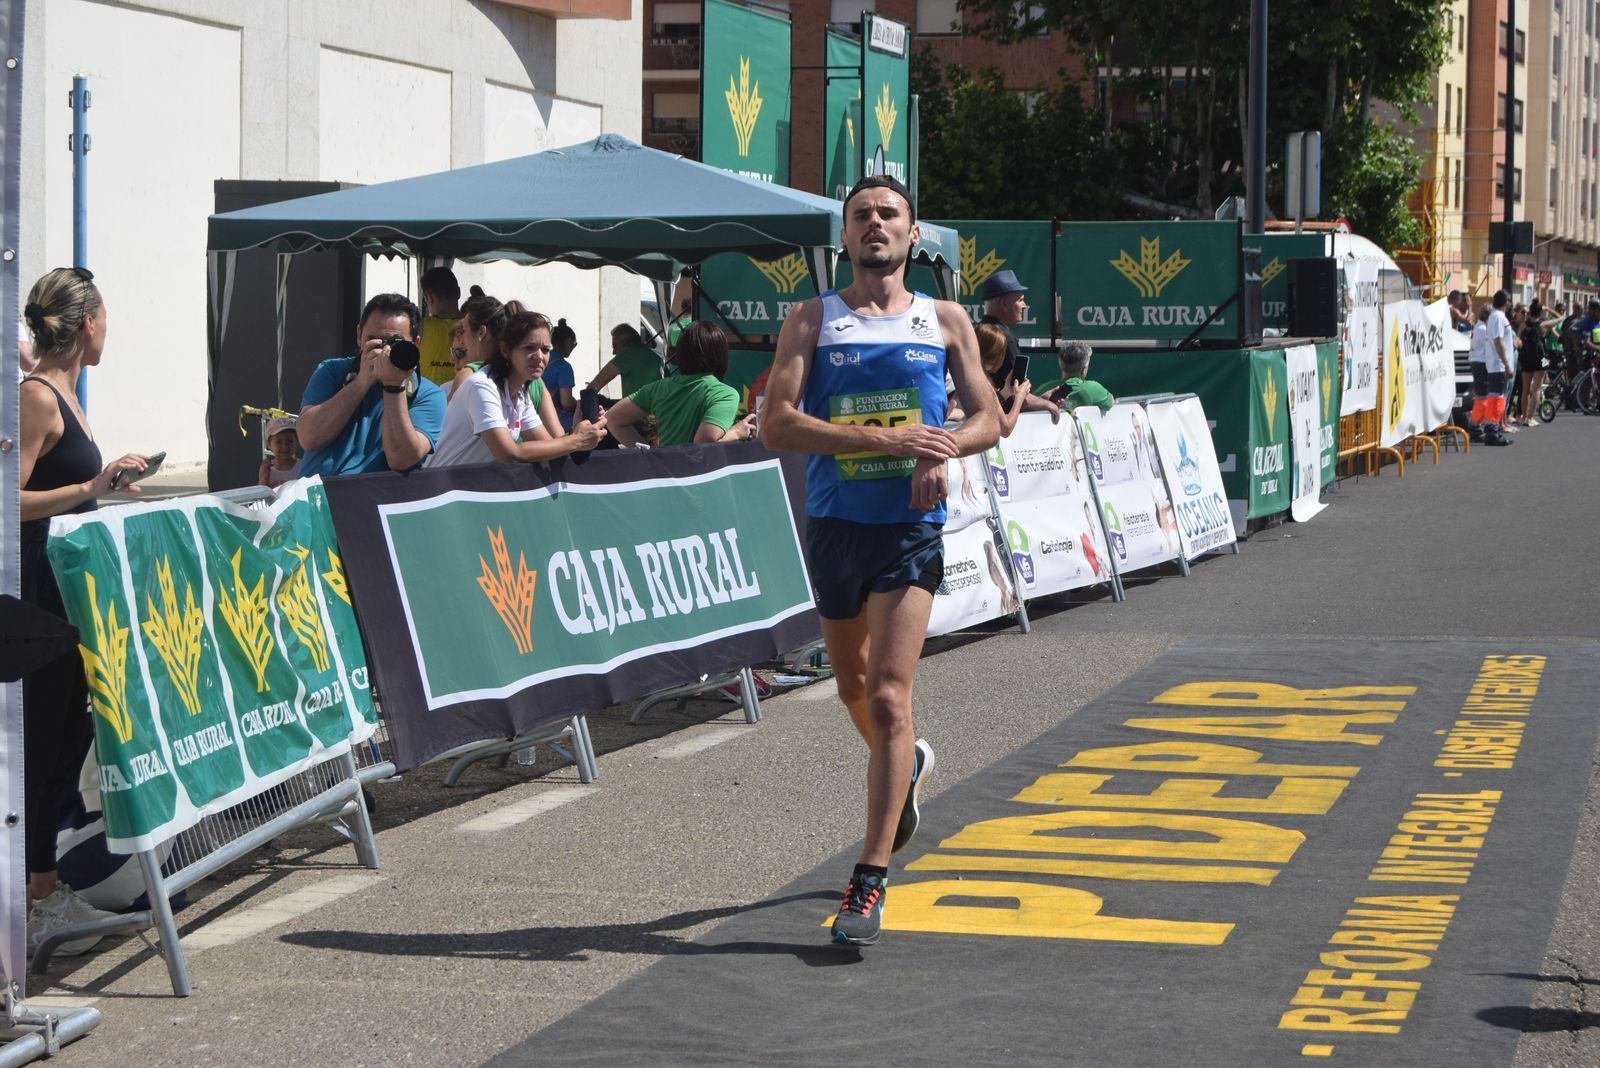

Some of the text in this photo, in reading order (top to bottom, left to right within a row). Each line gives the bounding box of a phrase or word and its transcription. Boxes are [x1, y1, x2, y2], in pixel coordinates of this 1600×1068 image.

[716, 301, 770, 321] CAJA
[1077, 306, 1226, 327] CAJA RURAL
[855, 392, 908, 405] FUNDACION
[856, 401, 909, 413] CAJA RURAL
[861, 463, 885, 472] CAJA
[1177, 491, 1229, 538] OCEANIC
[548, 527, 761, 636] CAJA RURAL
[173, 721, 234, 767] CAJA RURAL
[821, 681, 1417, 946] PIDEPAR
[1277, 654, 1547, 1034] REFORMA INTEGRAL DISEÑO INTERIORES
